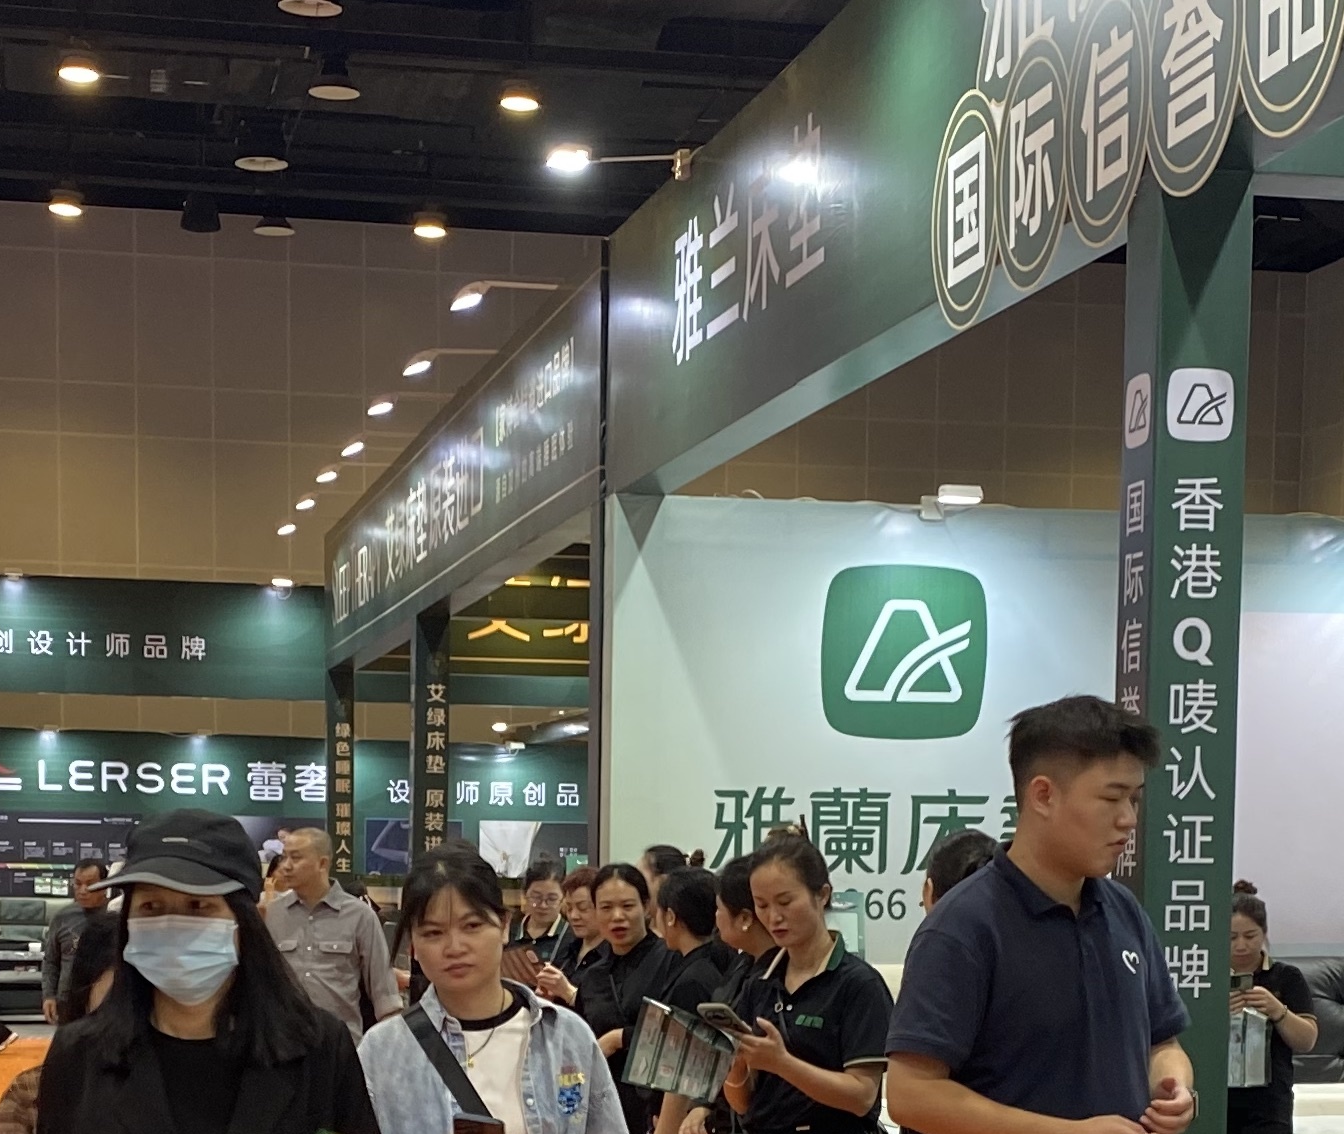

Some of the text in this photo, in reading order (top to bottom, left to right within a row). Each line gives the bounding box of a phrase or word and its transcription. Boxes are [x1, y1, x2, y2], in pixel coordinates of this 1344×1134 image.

[672, 112, 826, 366] 雅兰床垫
[37, 758, 231, 796] LERSER
[426, 683, 446, 775] 艾绿床垫
[1162, 477, 1224, 999] 香港Q唛认证品牌
